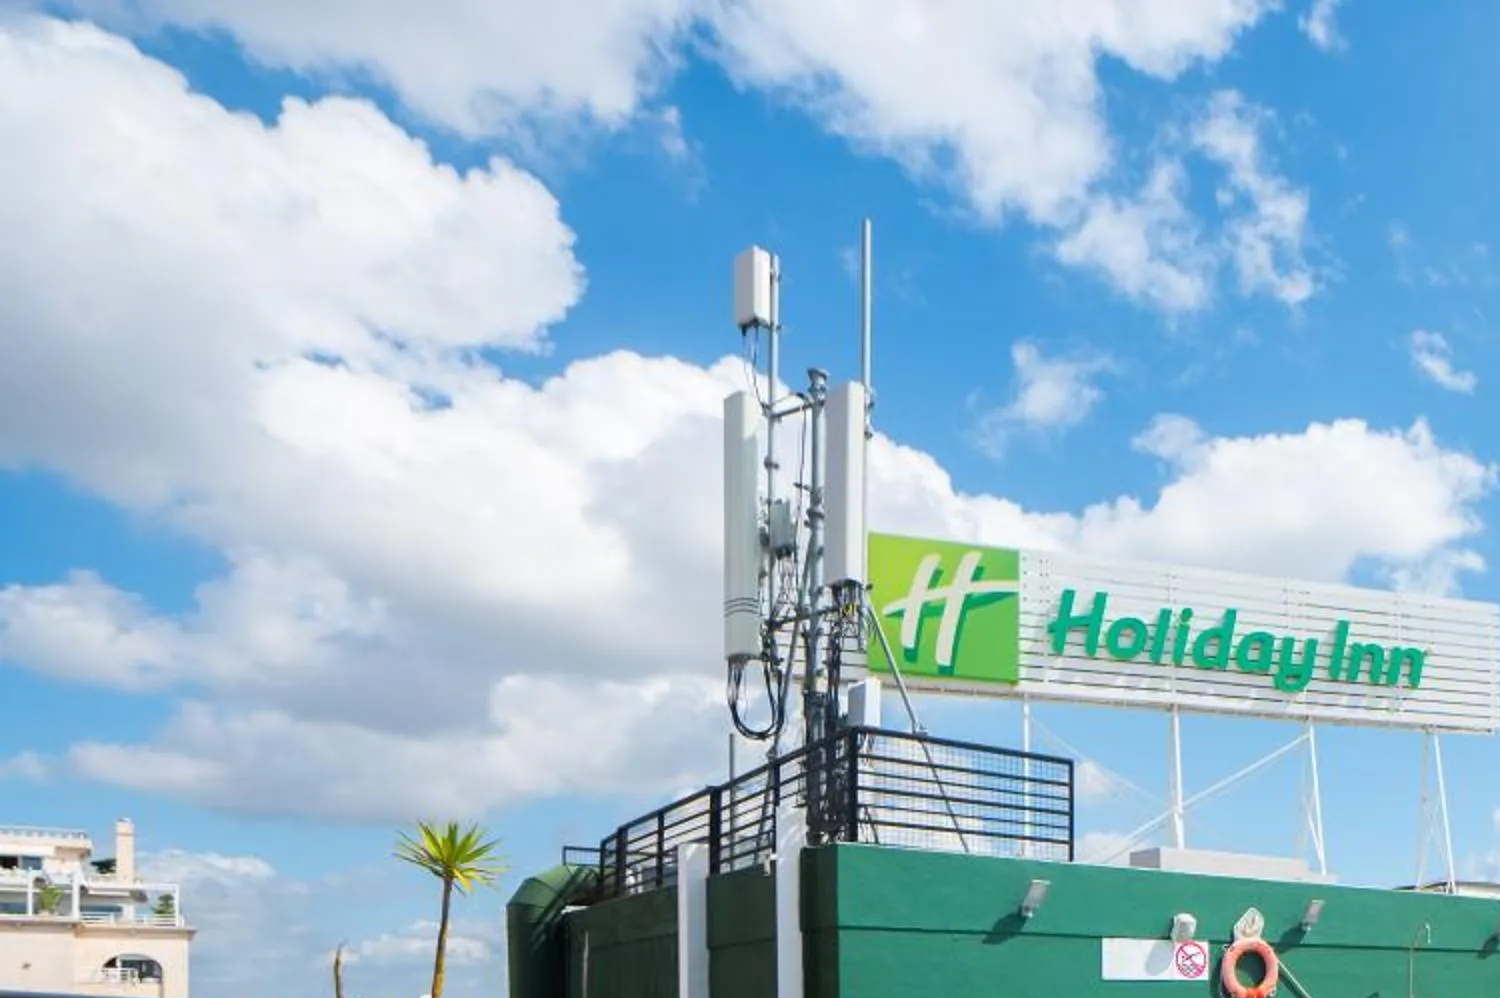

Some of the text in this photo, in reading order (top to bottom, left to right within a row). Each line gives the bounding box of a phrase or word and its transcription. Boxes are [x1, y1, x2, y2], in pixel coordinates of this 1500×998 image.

[883, 550, 1018, 672] H
[1047, 589, 1427, 692] Holiday Inn
